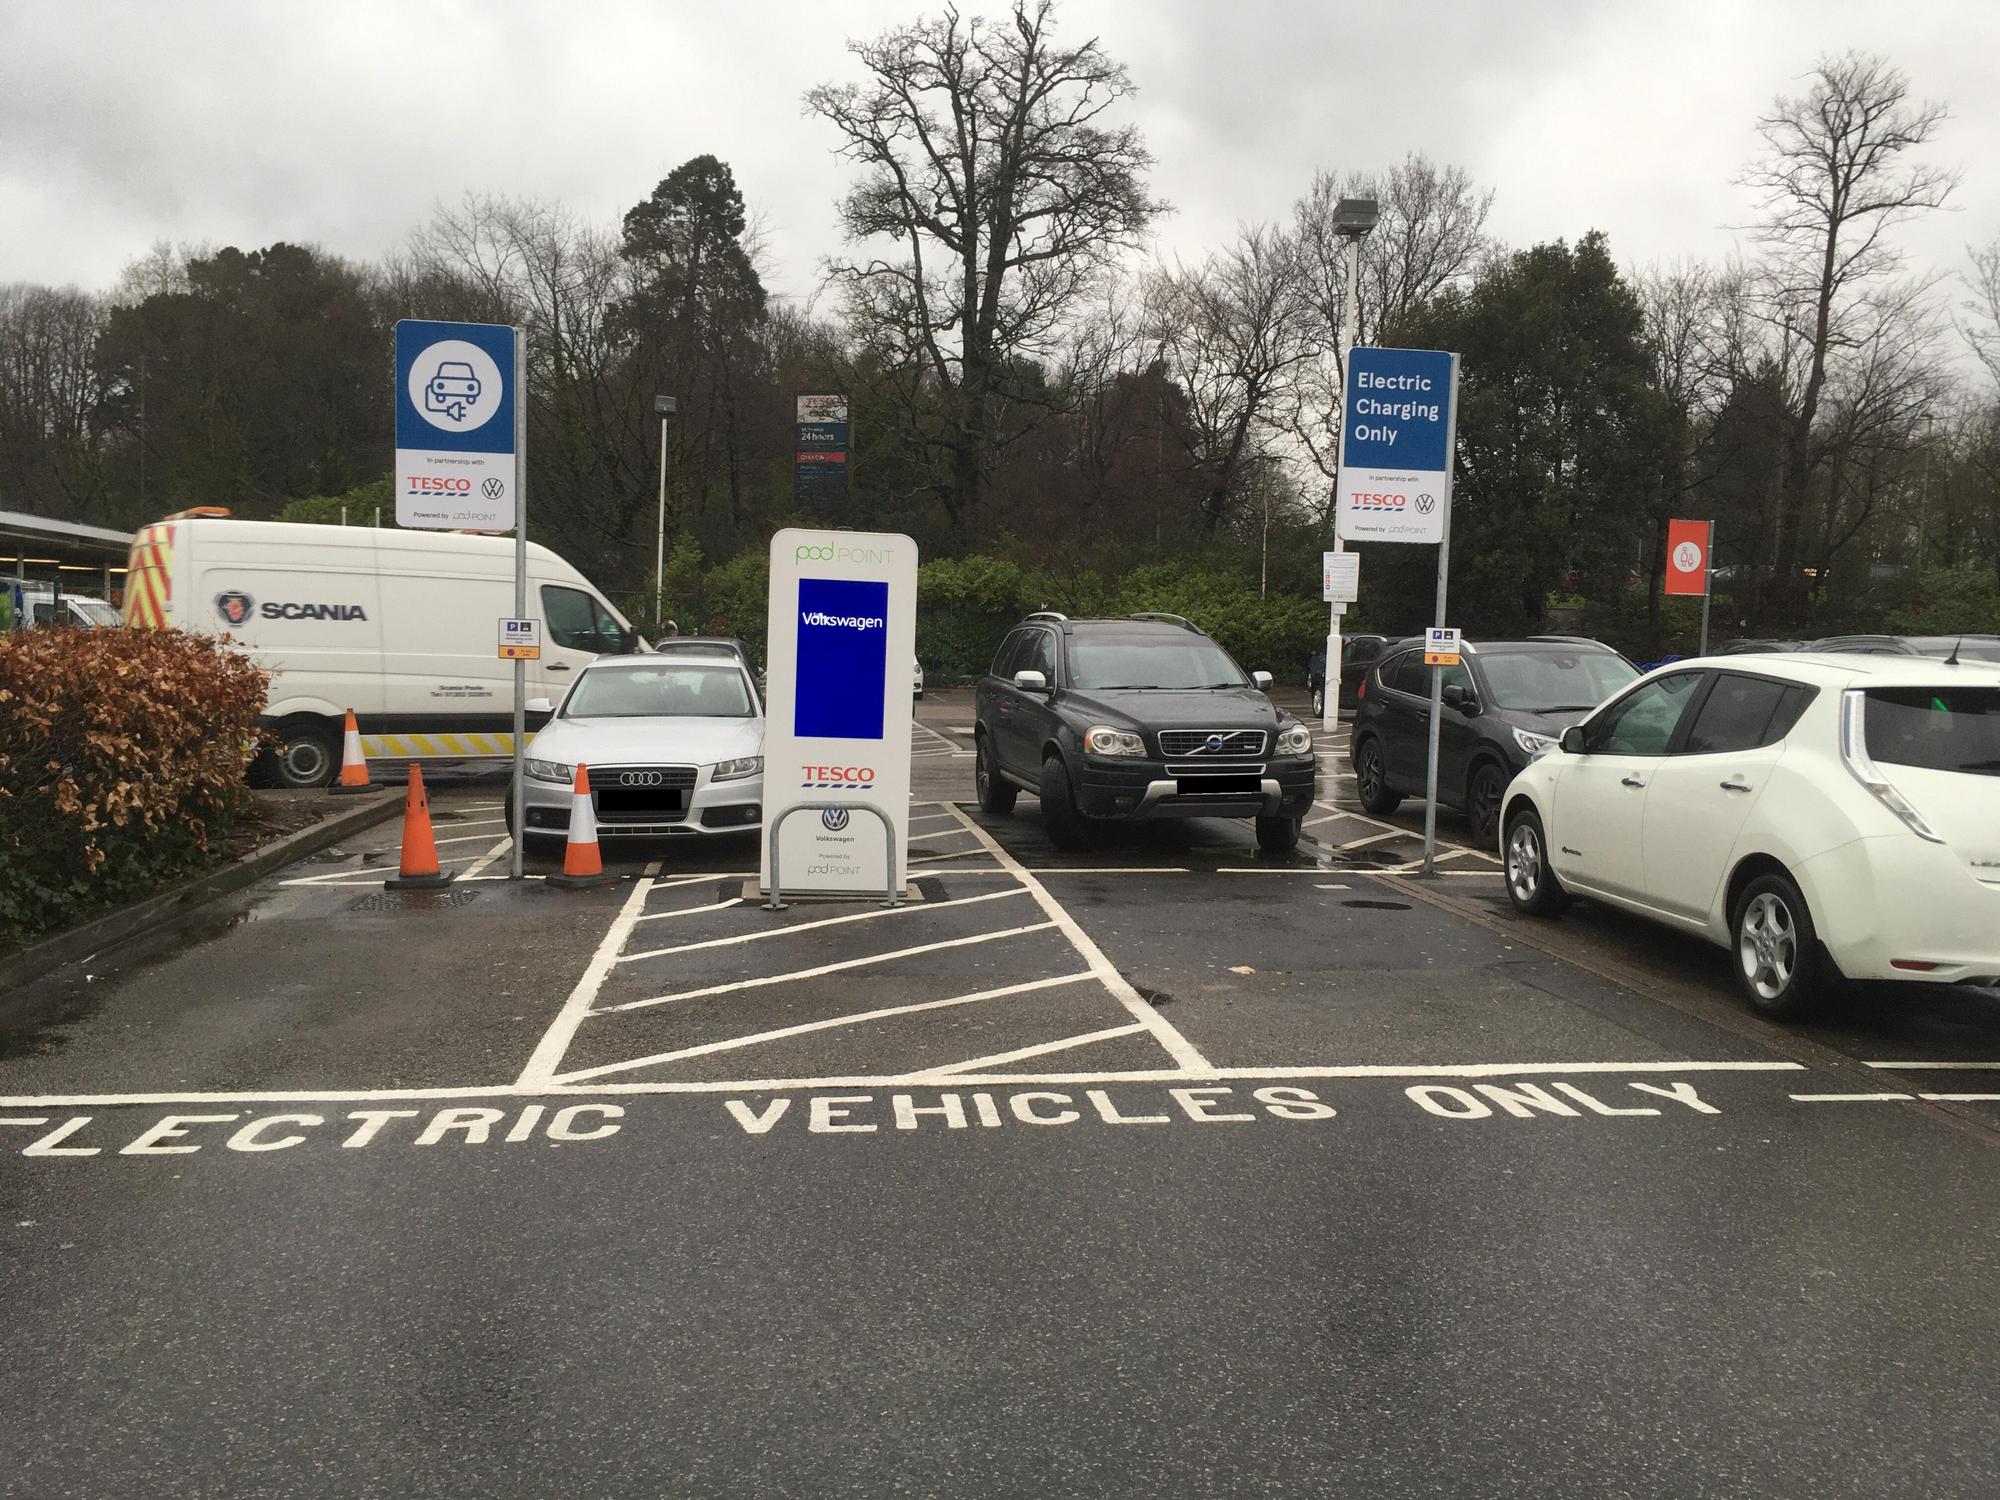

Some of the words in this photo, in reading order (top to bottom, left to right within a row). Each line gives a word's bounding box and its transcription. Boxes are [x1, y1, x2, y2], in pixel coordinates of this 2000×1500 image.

[1358, 372, 1432, 391] Electric
[1355, 398, 1439, 421] Charging
[801, 432, 811, 441] 24
[1354, 425, 1398, 446] Only
[434, 458, 471, 466] partnership
[407, 476, 471, 491] TESCO
[1351, 493, 1406, 507] TESCO
[413, 511, 440, 519] Powered
[441, 512, 449, 520] by
[1354, 525, 1379, 533] Powered
[796, 540, 834, 566] pod
[838, 547, 895, 564] POINT
[261, 602, 368, 621] SCANIA
[802, 612, 883, 631] Volkswagen
[802, 765, 875, 782] TESCO
[816, 835, 855, 844] Volkswagen
[830, 866, 861, 876] POINT
[725, 1086, 1337, 1133] VEHICLES
[1405, 1082, 1722, 1118] ONLY
